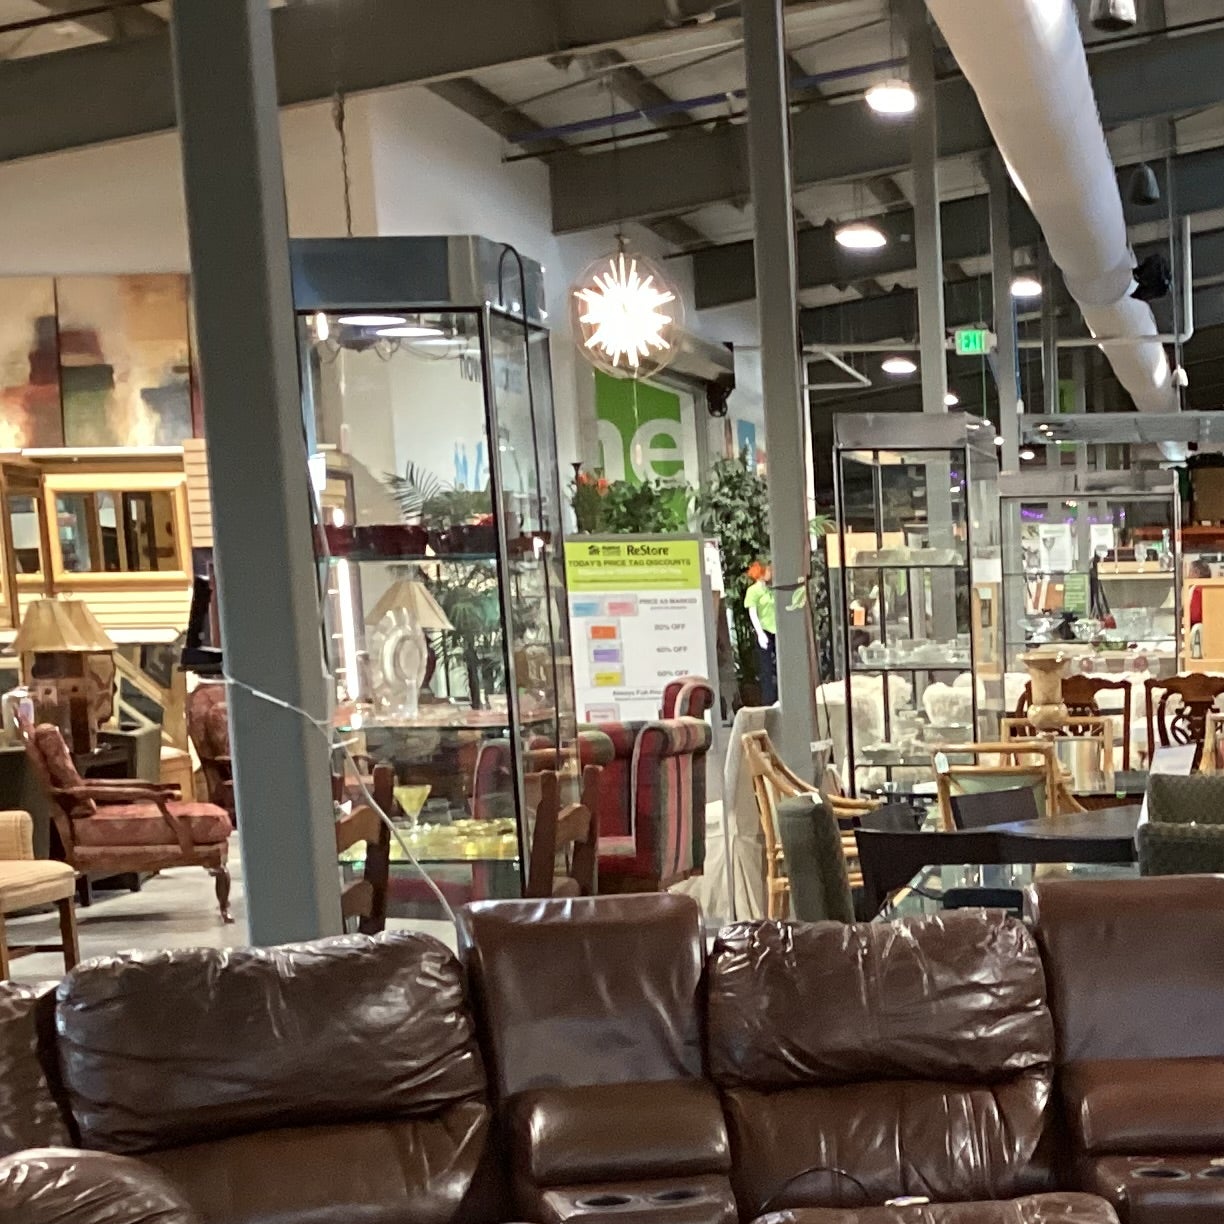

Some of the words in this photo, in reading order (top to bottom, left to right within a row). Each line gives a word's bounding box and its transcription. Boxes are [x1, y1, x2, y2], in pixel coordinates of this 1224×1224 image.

[626, 544, 669, 556] ReStore
[603, 559, 626, 567] PRICE
[646, 558, 691, 566] DISCOUNTS
